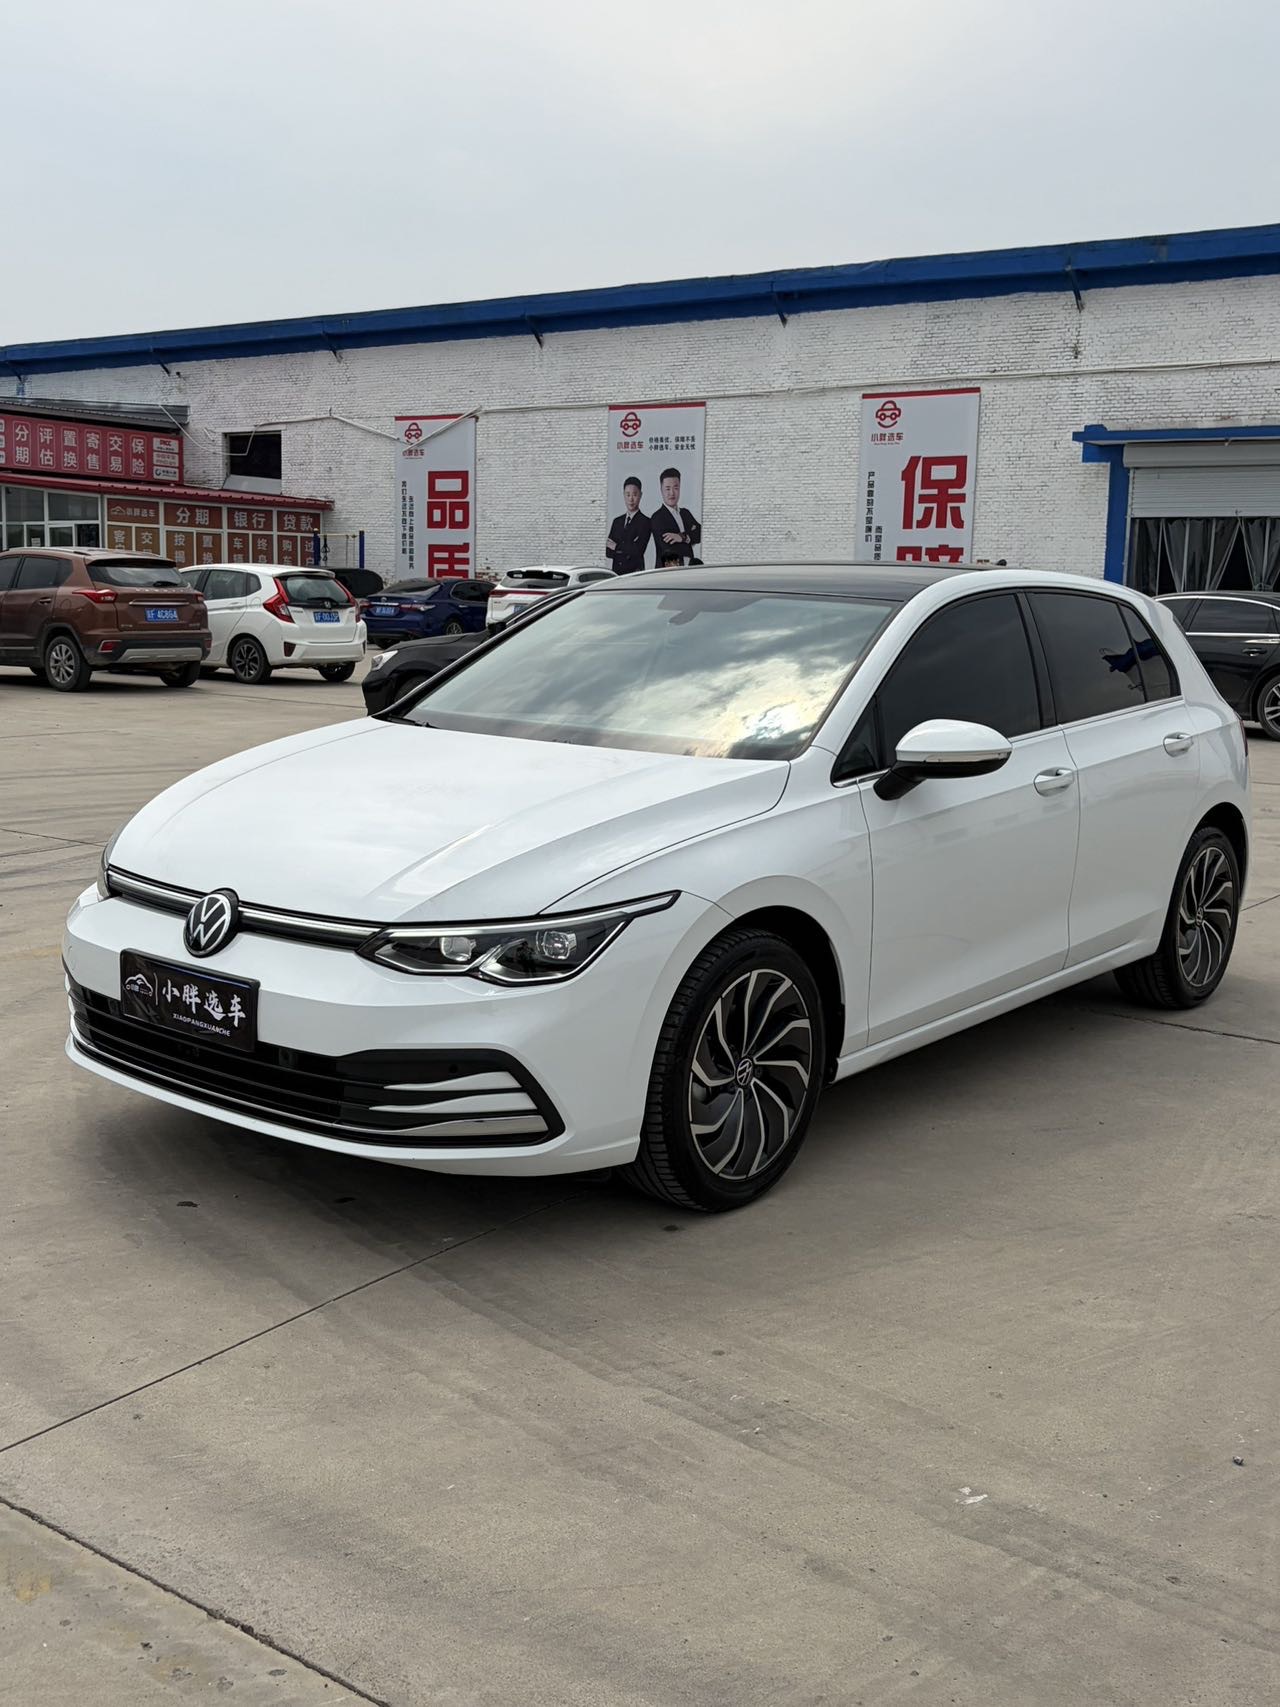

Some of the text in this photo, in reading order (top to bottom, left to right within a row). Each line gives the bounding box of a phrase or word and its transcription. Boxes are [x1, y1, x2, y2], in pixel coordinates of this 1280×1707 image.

[15, 425, 29, 463] 分期
[40, 427, 53, 466] 评估
[64, 430, 77, 468] 置换
[87, 433, 99, 470] 寄售
[109, 436, 122, 472] 交易
[132, 438, 145, 474] 保险
[176, 507, 313, 531] 分期 银行 贷款
[896, 455, 968, 563] 保
[162, 979, 246, 1027] 小胖选车
[173, 1013, 231, 1037] XIAOPANGXUANCHE
